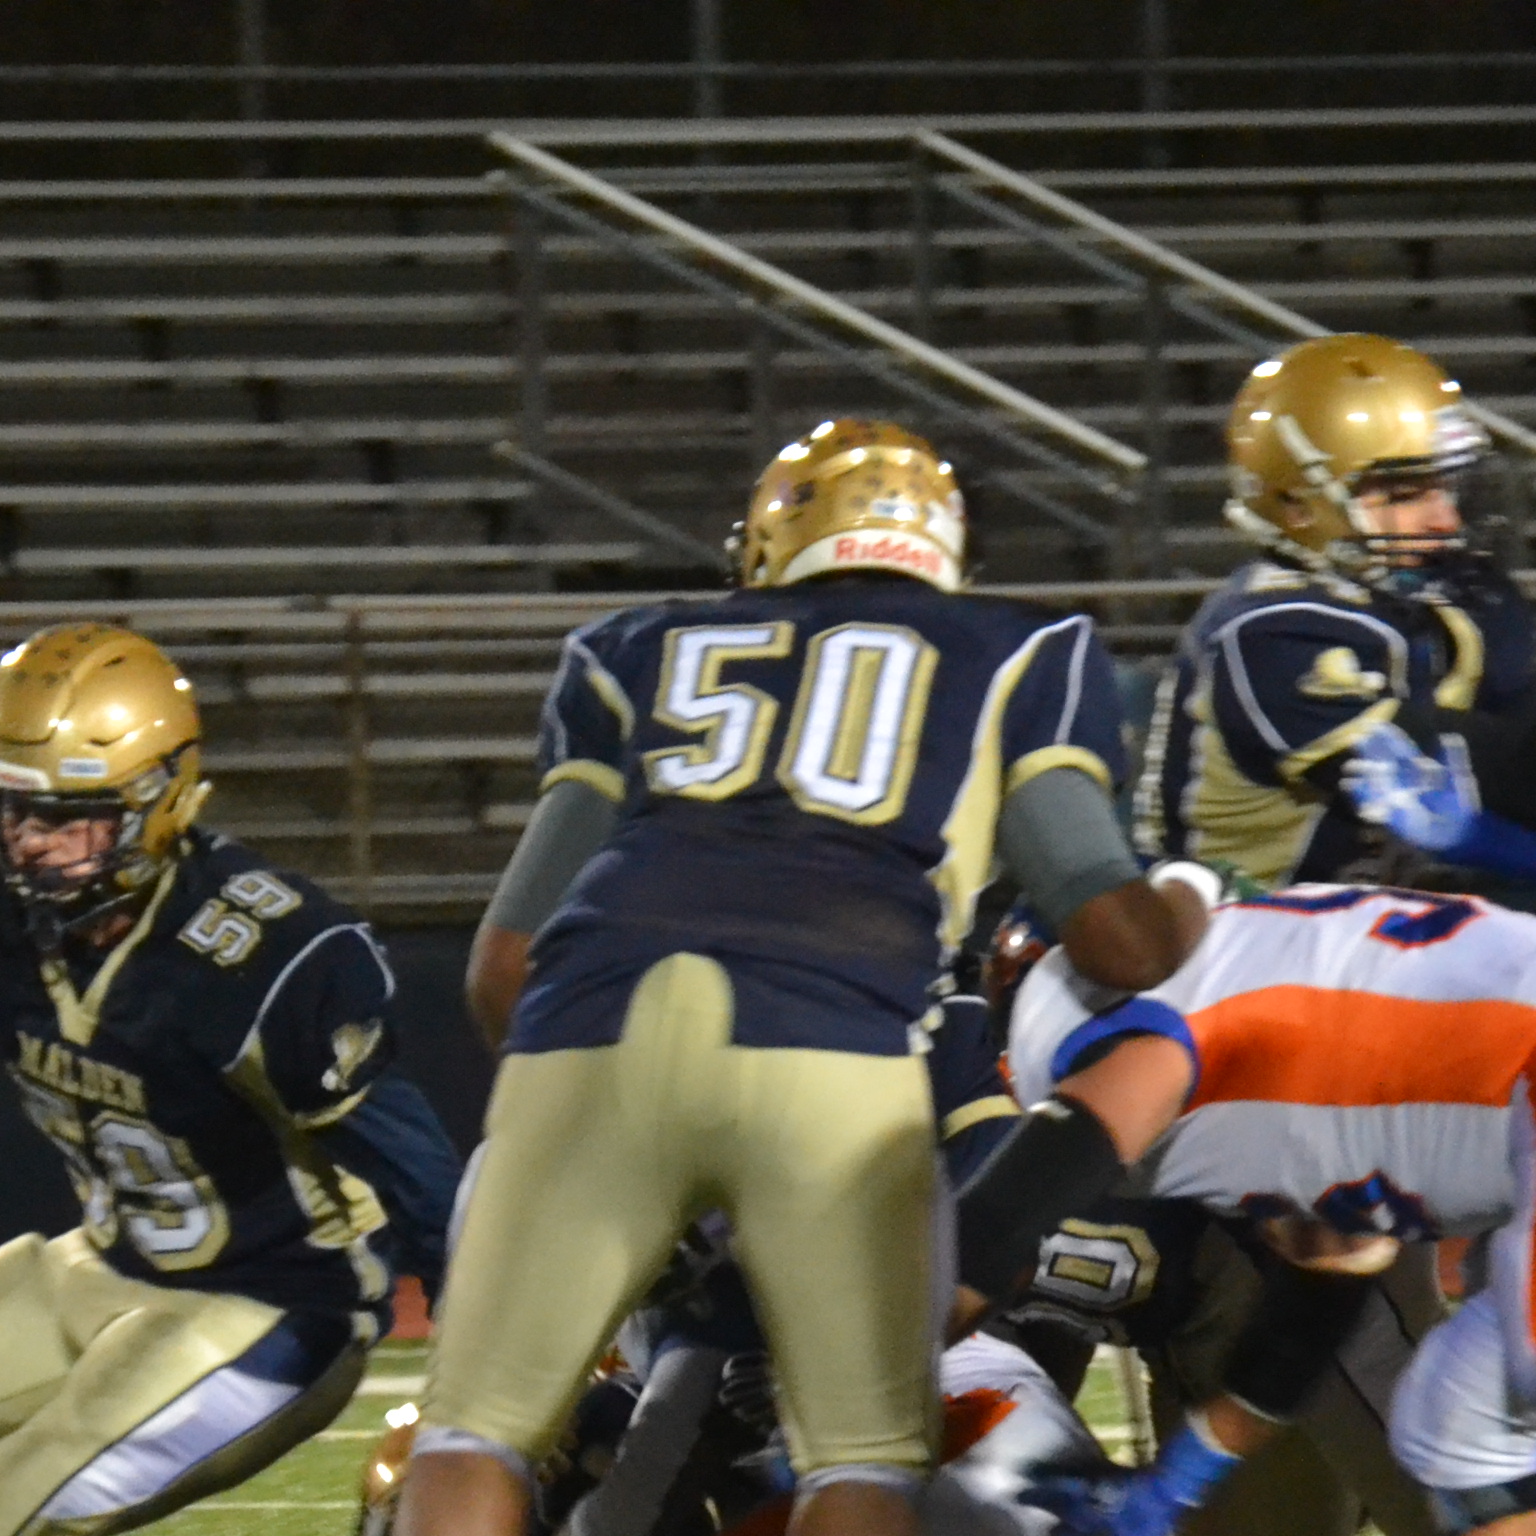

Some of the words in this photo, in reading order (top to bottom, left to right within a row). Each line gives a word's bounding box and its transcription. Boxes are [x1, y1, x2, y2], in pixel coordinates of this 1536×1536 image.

[834, 536, 942, 575] Riddell
[641, 619, 941, 827] 50
[175, 868, 304, 968] 59
